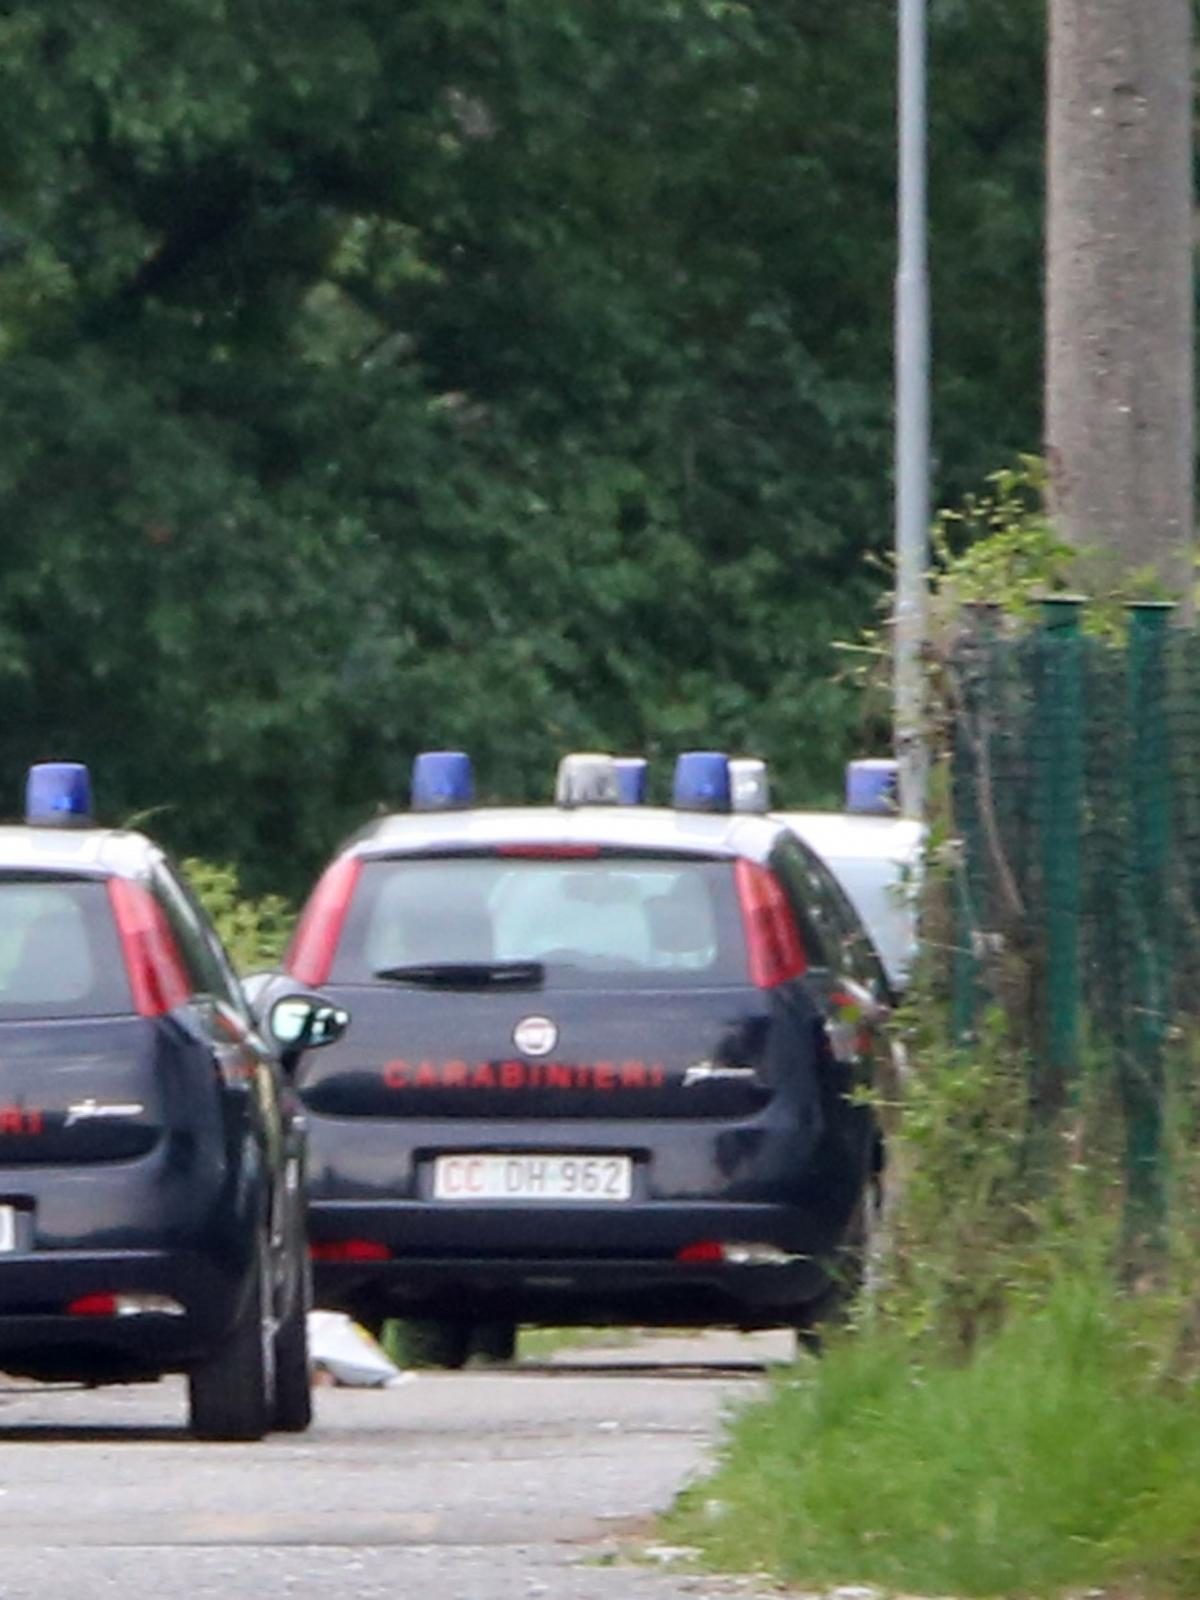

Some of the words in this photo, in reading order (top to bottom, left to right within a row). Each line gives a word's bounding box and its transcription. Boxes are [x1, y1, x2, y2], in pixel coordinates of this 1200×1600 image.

[383, 1060, 664, 1089] CARABINIERI
[442, 1161, 484, 1193] CC
[505, 1161, 546, 1193] DH
[560, 1161, 620, 1195] 962
